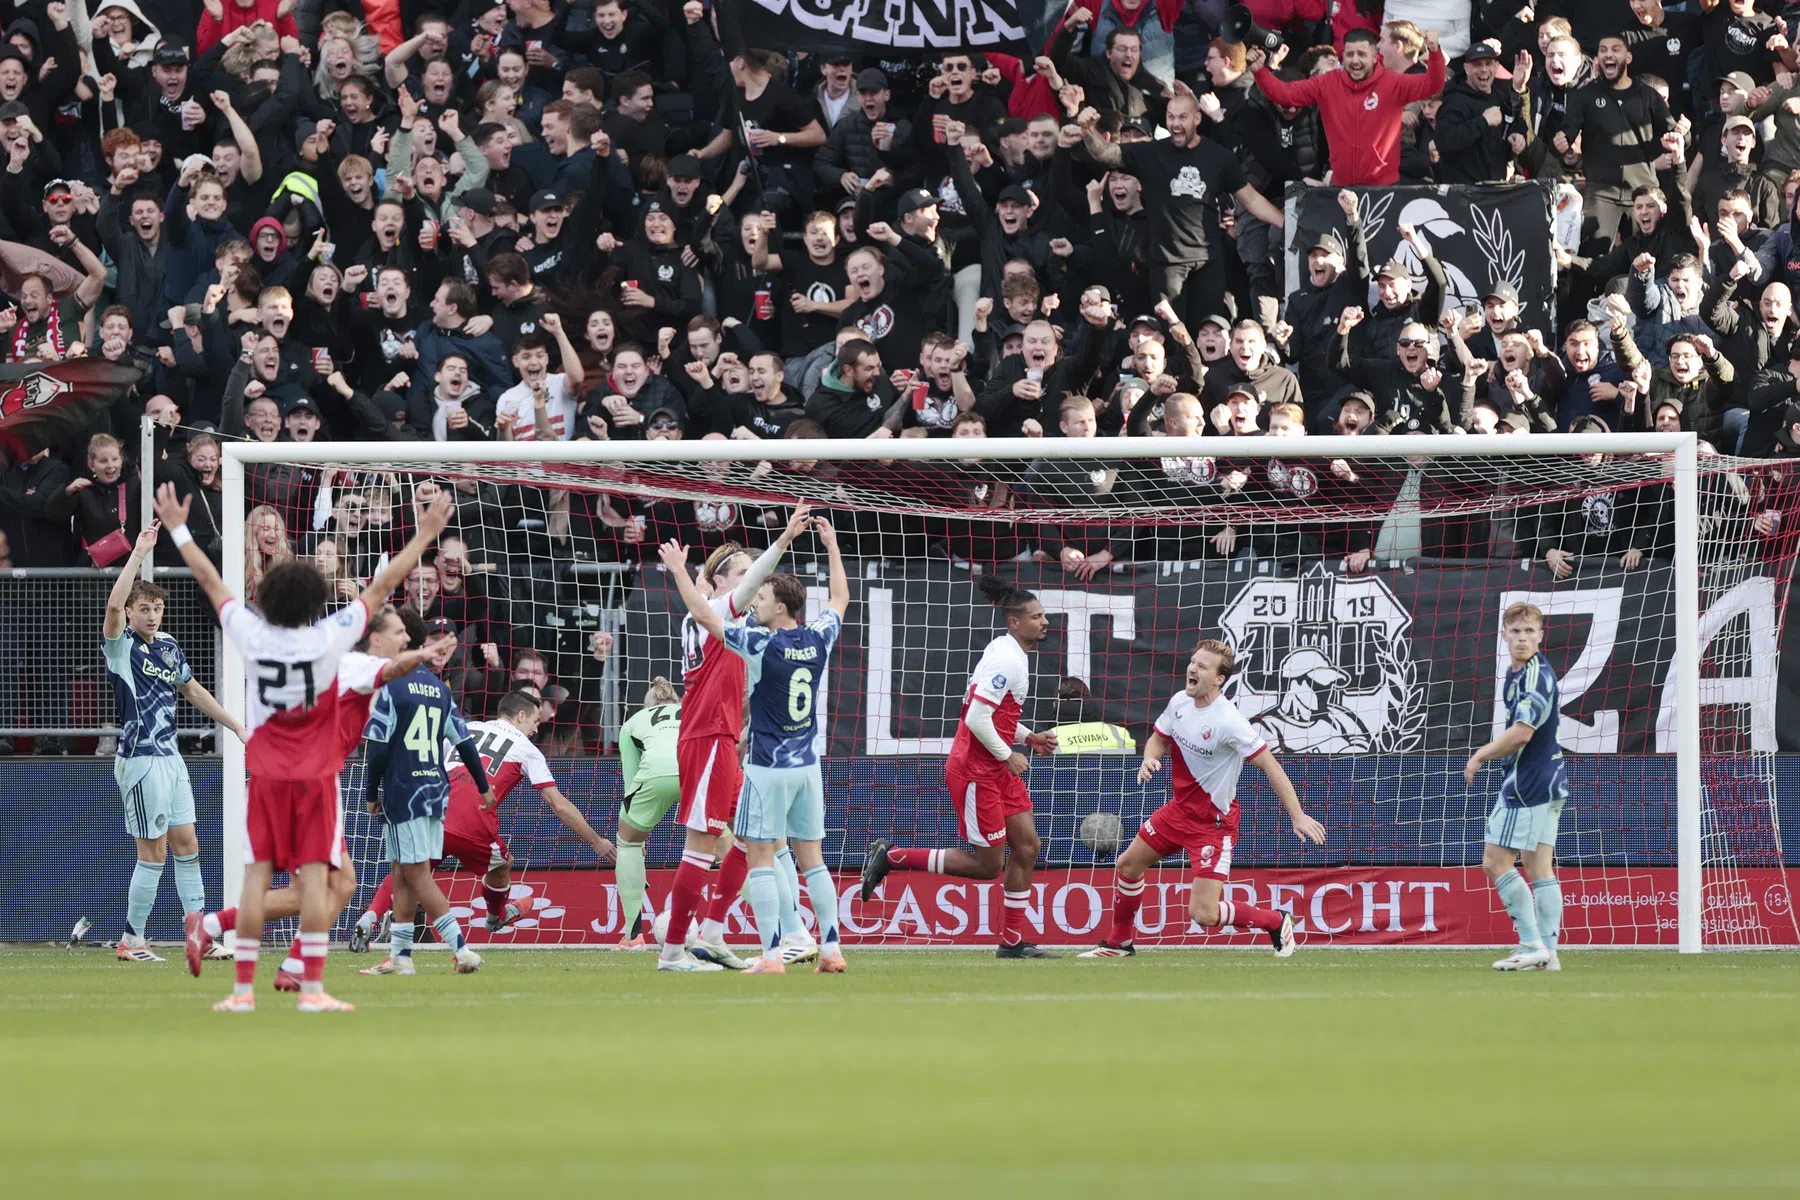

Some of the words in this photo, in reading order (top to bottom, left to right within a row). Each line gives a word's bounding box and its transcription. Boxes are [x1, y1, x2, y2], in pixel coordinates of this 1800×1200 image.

[1253, 595, 1286, 617] 20
[1346, 595, 1375, 618] 19
[257, 659, 315, 710] 21
[407, 682, 441, 698] ALDERS
[788, 667, 813, 722] 6
[404, 704, 442, 765] 41
[1067, 733, 1109, 746] STEWARD
[838, 882, 1103, 935] CASINO
[1580, 891, 1632, 909] gokken
[1634, 891, 1667, 909] jou?
[1655, 914, 1756, 932] jacasino.nl
